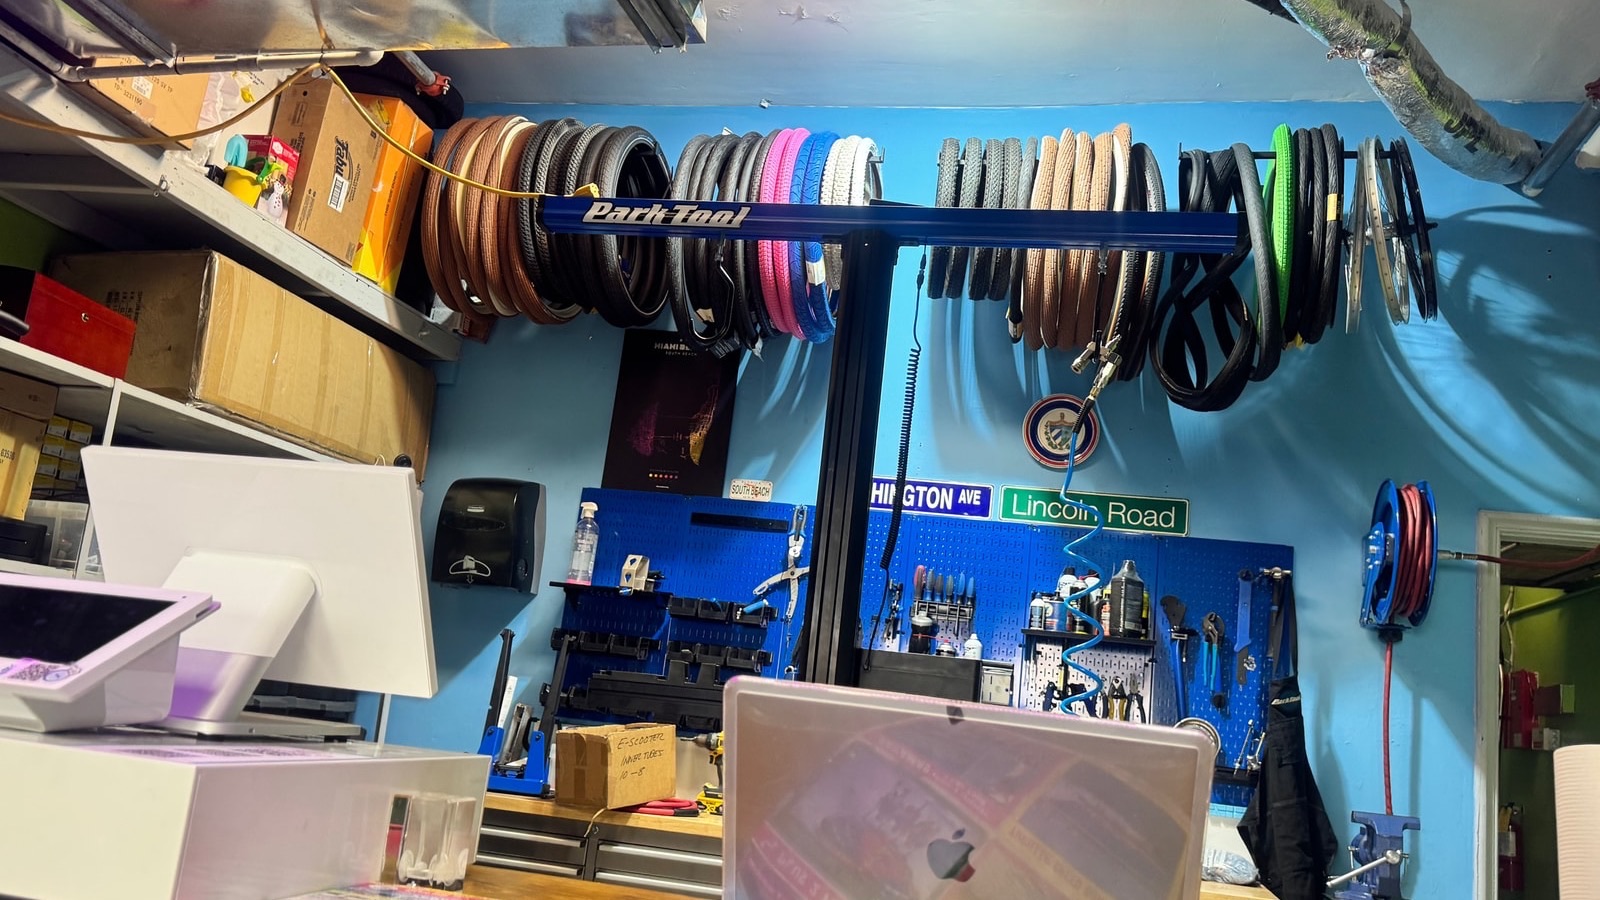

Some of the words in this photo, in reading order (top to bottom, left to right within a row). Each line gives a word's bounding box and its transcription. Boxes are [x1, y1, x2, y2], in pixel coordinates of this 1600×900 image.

[582, 201, 668, 225] Park
[666, 204, 751, 228] Tool
[732, 484, 750, 495] SOUTH
[751, 486, 770, 497] BEACH
[958, 489, 982, 505] AVE
[1012, 493, 1099, 523] Lincoln
[1108, 501, 1176, 528] Road
[617, 733, 665, 749] E-SCOOTER
[643, 749, 665, 760] TUBES
